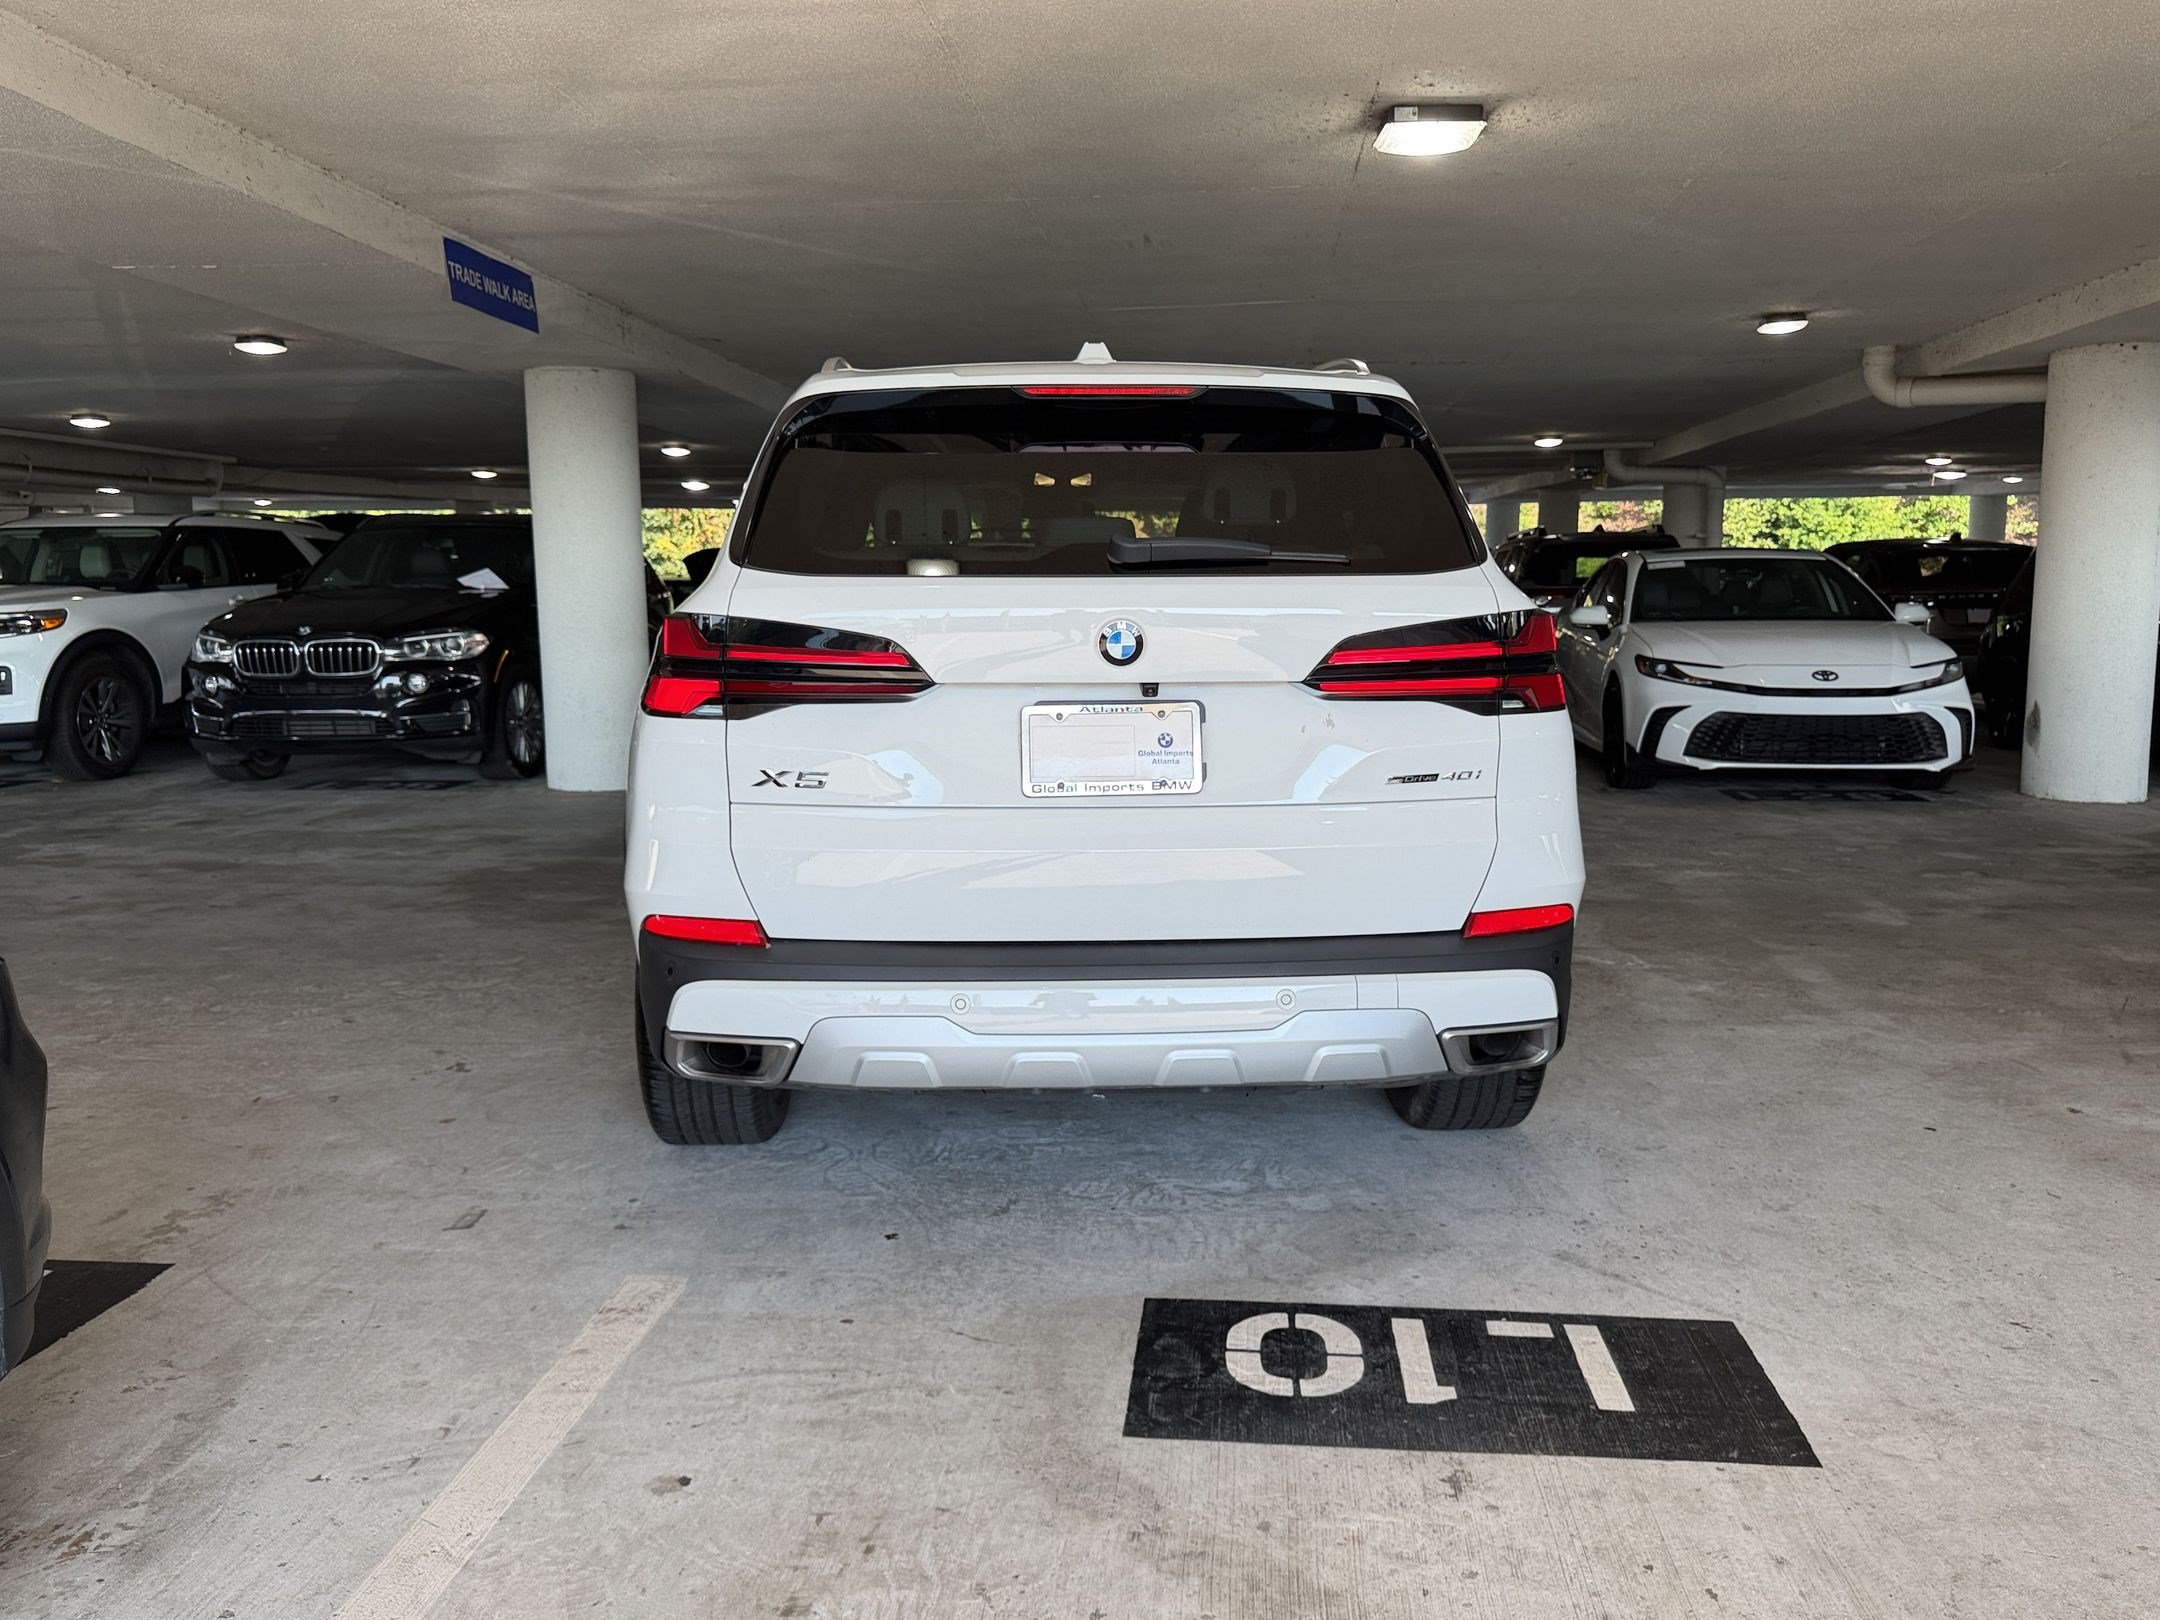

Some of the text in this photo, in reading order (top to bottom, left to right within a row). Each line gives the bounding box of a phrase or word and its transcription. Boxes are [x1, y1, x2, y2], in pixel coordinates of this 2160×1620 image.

[448, 261, 536, 312] TRADE WALK AREA
[1103, 621, 1142, 638] BMW
[1079, 706, 1144, 714] Atlanta
[1164, 750, 1194, 758] Imports
[751, 769, 829, 790] X5
[1085, 783, 1145, 793] Imports
[1152, 781, 1192, 790] BMW
[1225, 1311, 1636, 1412] L10
